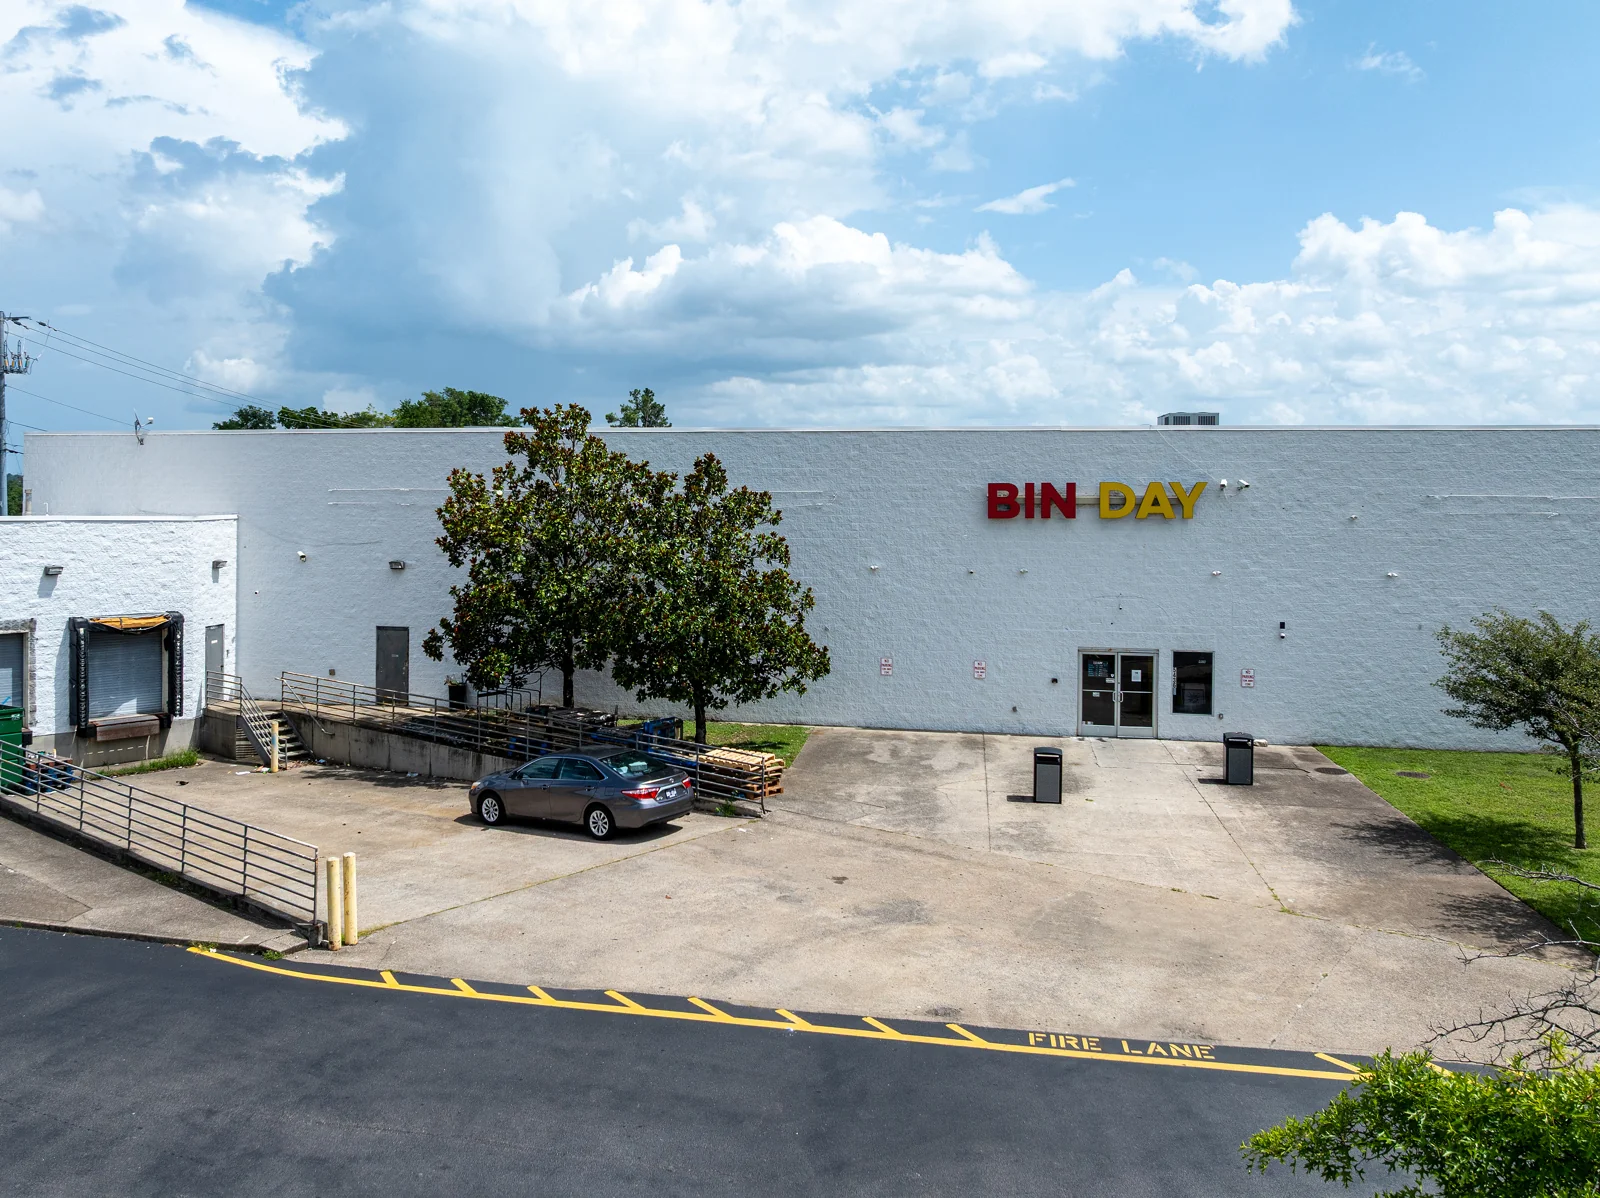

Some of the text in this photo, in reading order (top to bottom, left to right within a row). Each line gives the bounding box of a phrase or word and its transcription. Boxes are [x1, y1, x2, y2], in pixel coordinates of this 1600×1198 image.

[987, 481, 1208, 519] BIN DAY
[1028, 1032, 1216, 1060] FIRE LANE
